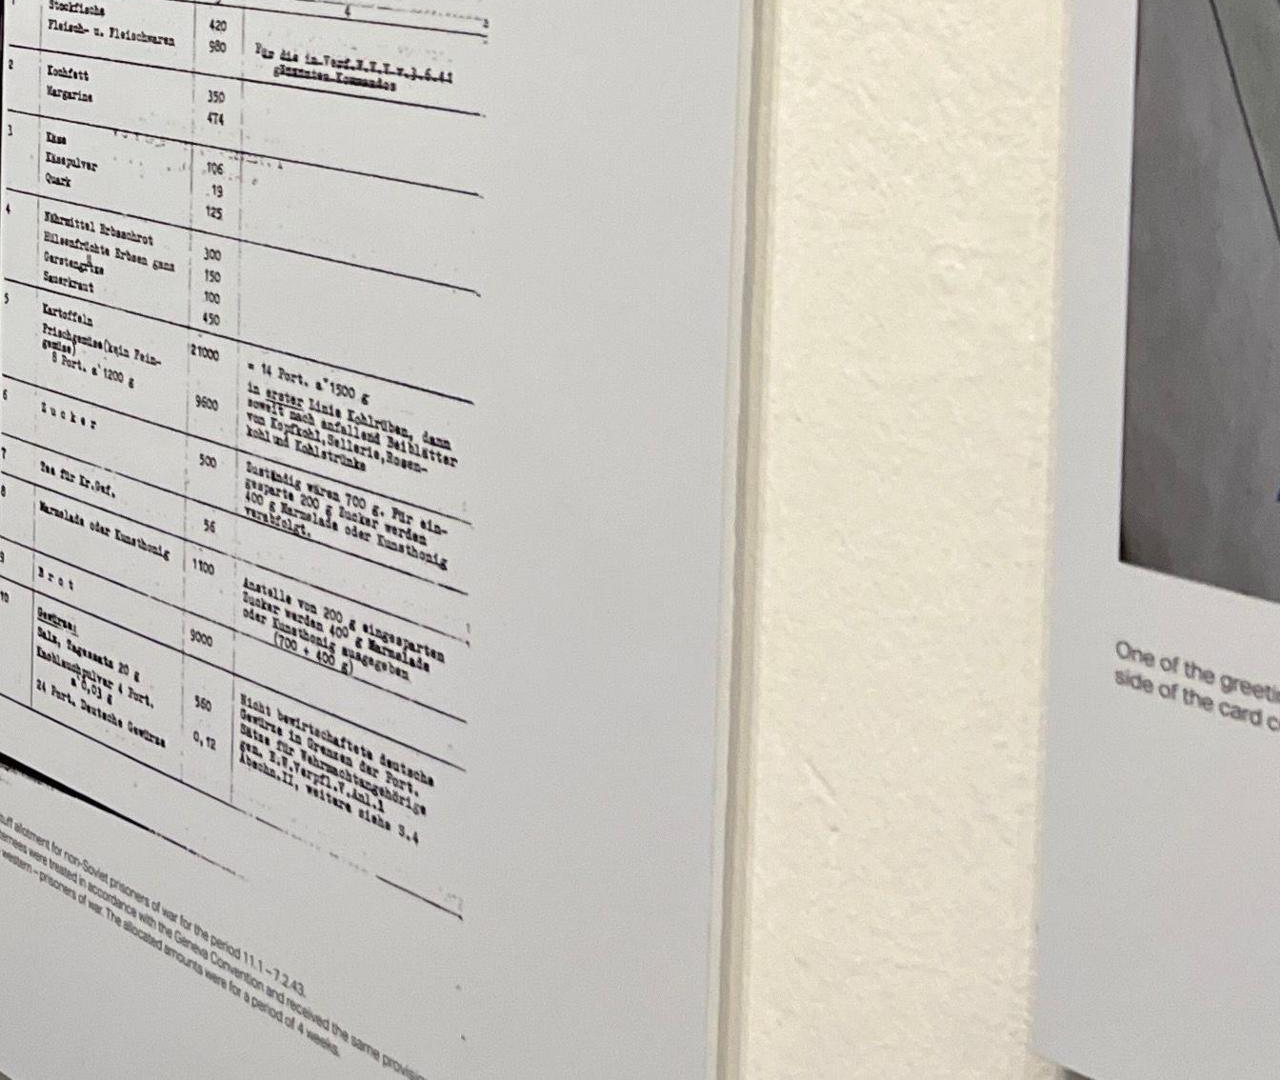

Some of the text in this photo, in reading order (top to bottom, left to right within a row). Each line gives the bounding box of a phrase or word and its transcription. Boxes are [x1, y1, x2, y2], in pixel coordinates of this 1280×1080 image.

[209, 19, 227, 32] 420
[208, 39, 226, 53] 980
[207, 89, 225, 103] 350
[206, 111, 224, 125] 474
[206, 161, 224, 175] 106
[212, 184, 223, 198] 19
[205, 205, 222, 220] 125
[203, 247, 222, 261] 300
[204, 268, 221, 283] 150
[204, 290, 220, 304] 100
[202, 312, 220, 326] 450
[190, 343, 219, 361] 21000
[195, 394, 218, 411] 9600
[1116, 640, 1155, 667] One
[1160, 656, 1179, 673] of
[1184, 661, 1215, 685] the
[1114, 670, 1154, 693] side
[1159, 684, 1178, 700] of
[1183, 688, 1214, 712] the
[1219, 702, 1263, 727] card
